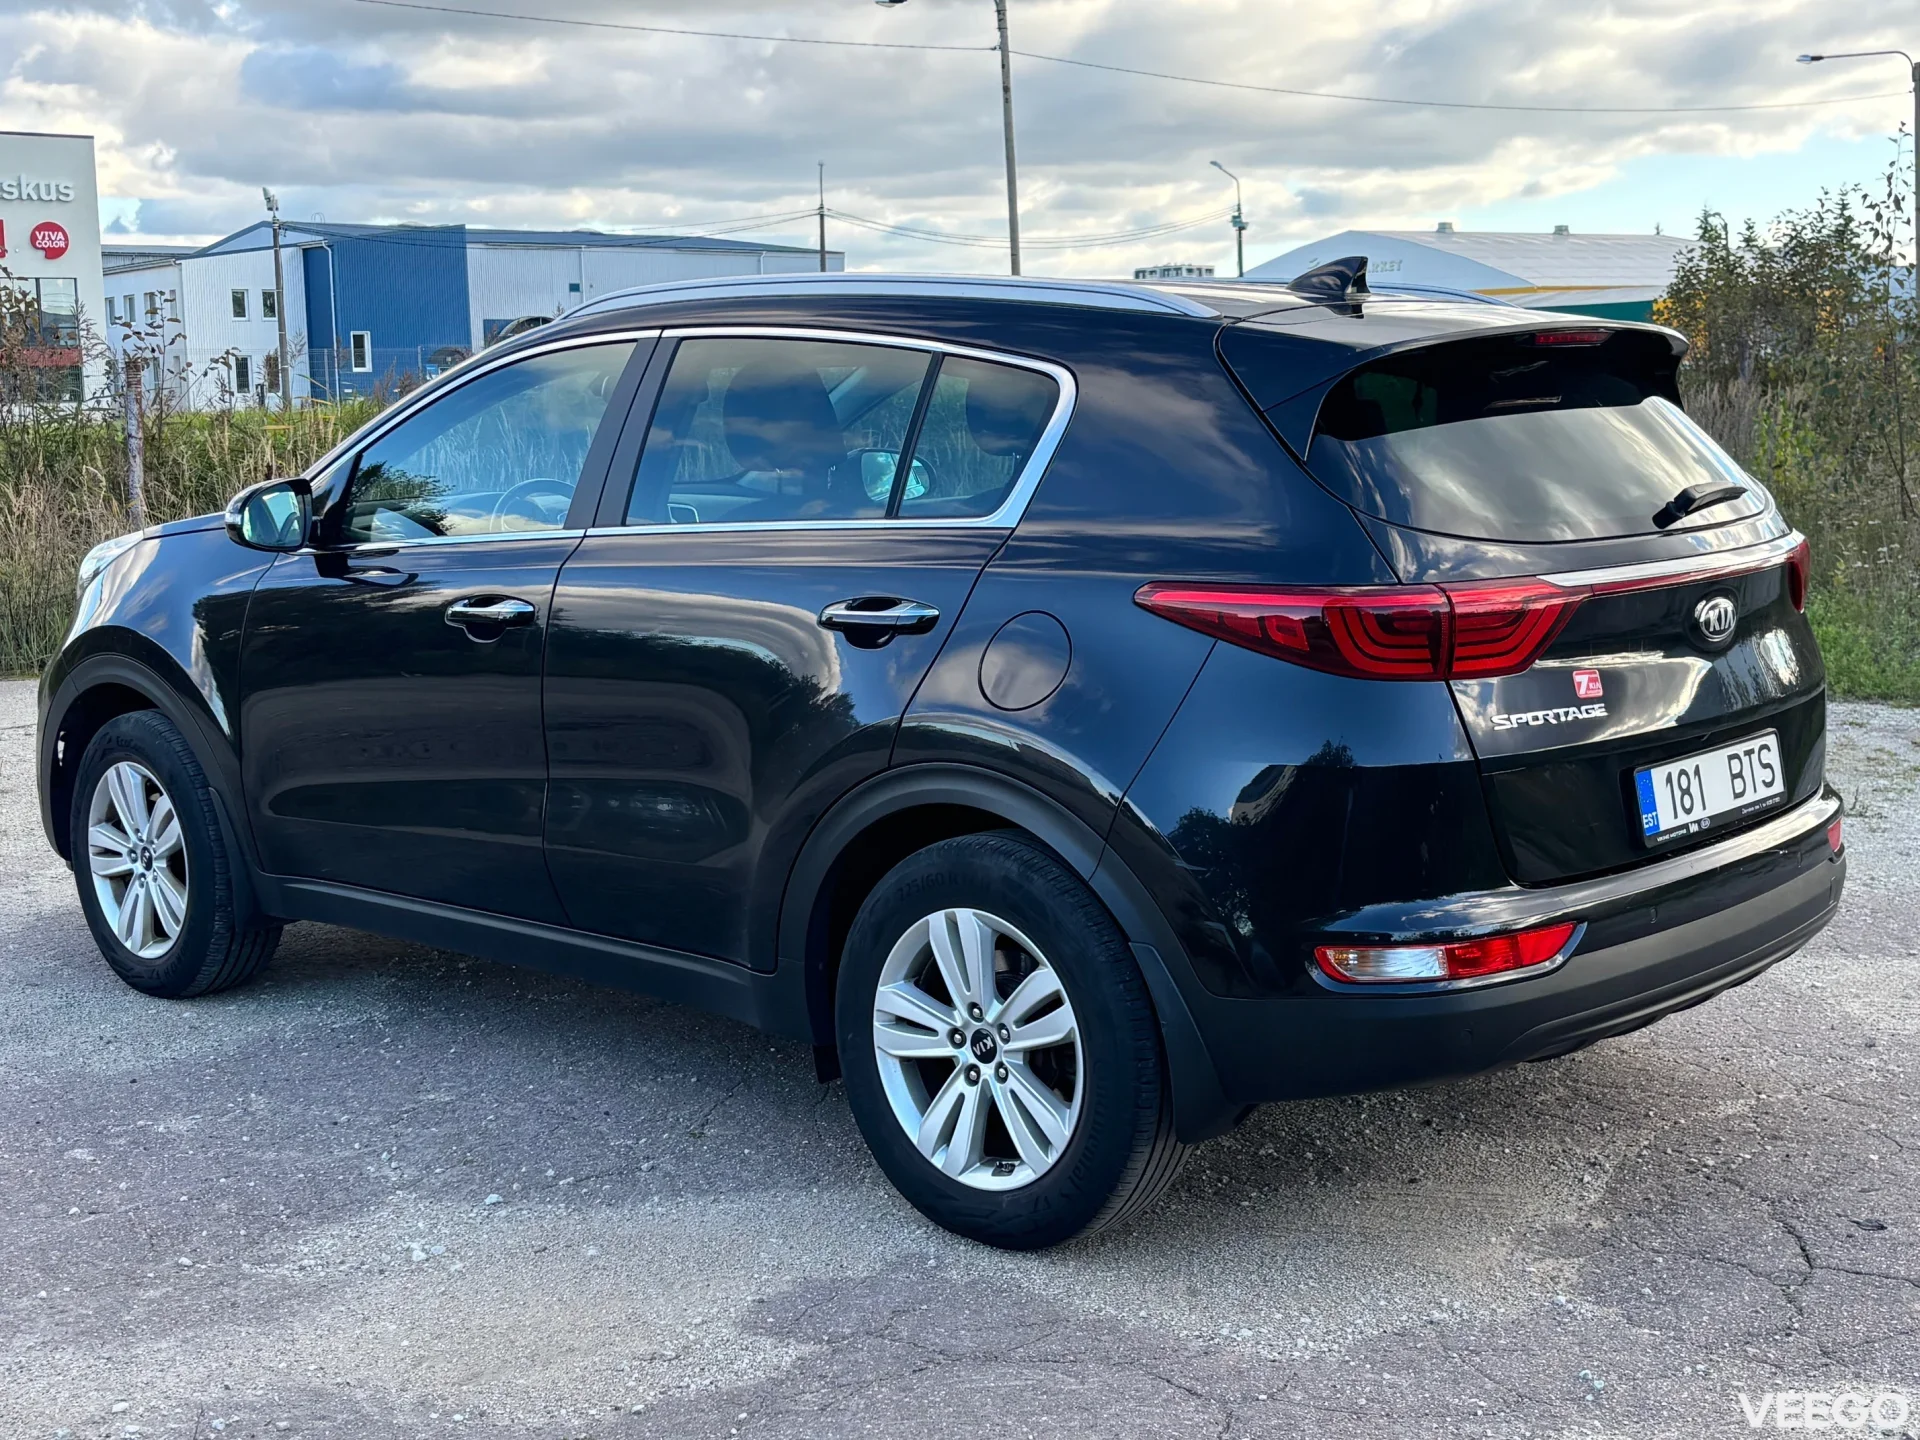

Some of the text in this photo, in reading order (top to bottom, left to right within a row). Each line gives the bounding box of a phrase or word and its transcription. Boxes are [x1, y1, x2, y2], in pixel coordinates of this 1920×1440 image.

[0, 173, 75, 202] skus
[35, 231, 65, 241] VIVA
[35, 240, 65, 248] COLOR
[1708, 606, 1735, 632] KIA
[1575, 674, 1589, 695] 7
[1491, 703, 1609, 731] SPORTAGE
[1665, 743, 1776, 820] 181 BTS
[1642, 811, 1658, 829] EST
[972, 1036, 994, 1056] KIA
